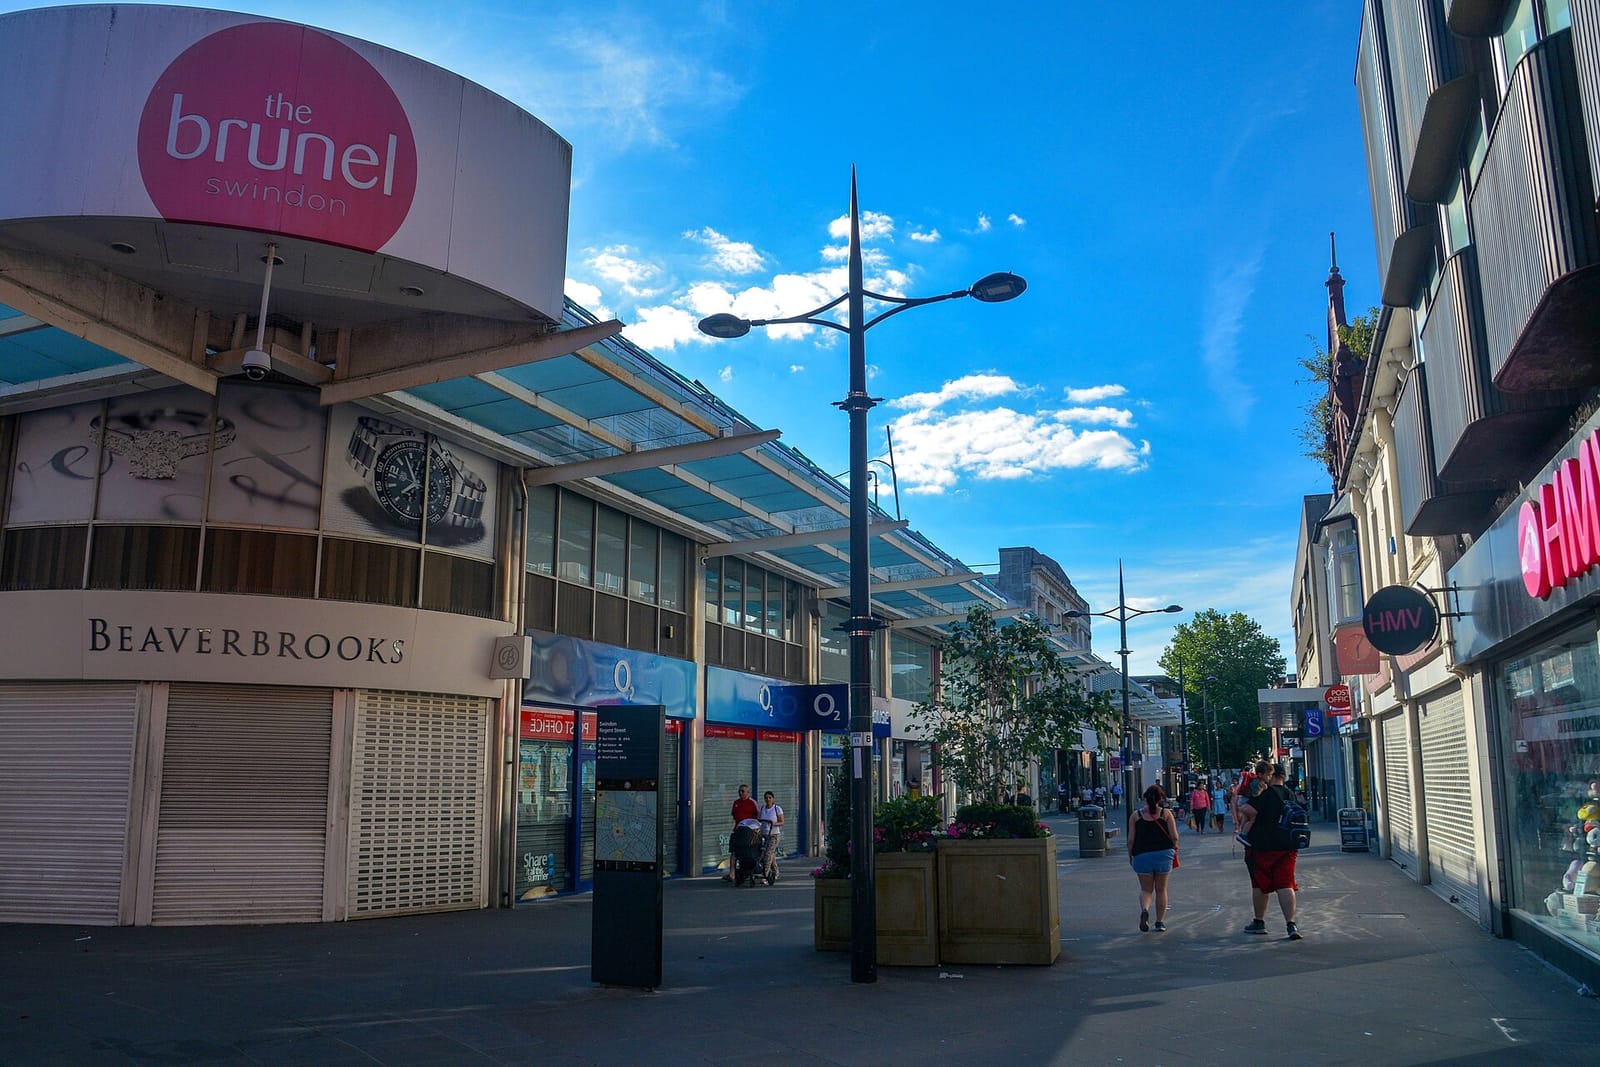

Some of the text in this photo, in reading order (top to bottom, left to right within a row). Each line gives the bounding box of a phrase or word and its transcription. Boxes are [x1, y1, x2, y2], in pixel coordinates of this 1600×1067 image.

[264, 92, 312, 124] the
[166, 93, 397, 196] brunel
[205, 177, 347, 217] swindon
[1368, 607, 1422, 634] HMV
[88, 618, 404, 664] BEAVERBROOKS
[813, 693, 841, 720] O2
[1308, 716, 1320, 735] S
[523, 852, 548, 868] Share
